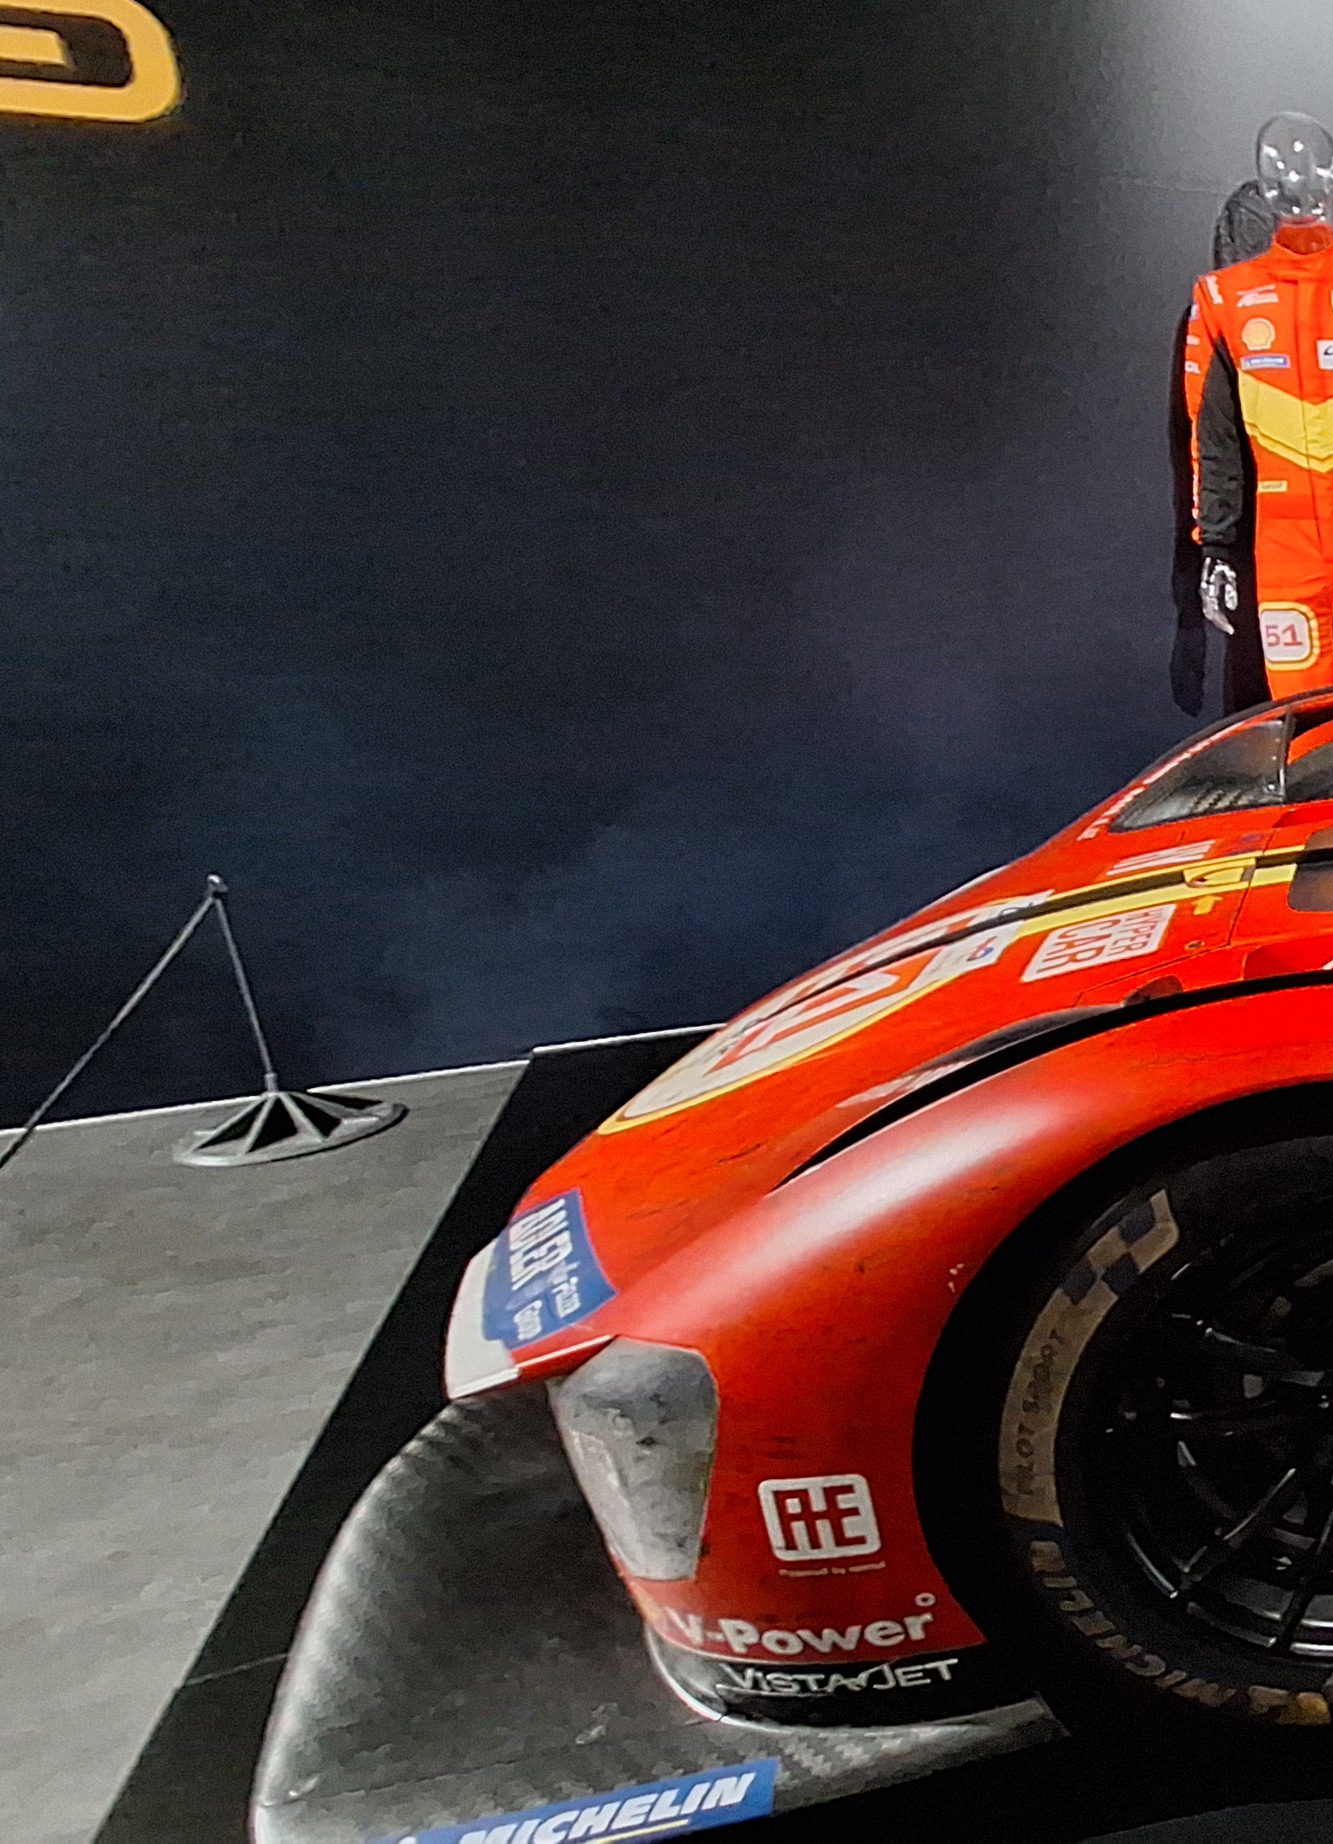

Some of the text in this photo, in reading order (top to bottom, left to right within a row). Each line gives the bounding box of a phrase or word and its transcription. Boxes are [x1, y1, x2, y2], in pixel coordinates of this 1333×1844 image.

[1265, 623, 1303, 647] 51
[1036, 918, 1121, 974] CAR
[1107, 906, 1166, 957] HYPER
[664, 1606, 934, 1656] V-Power
